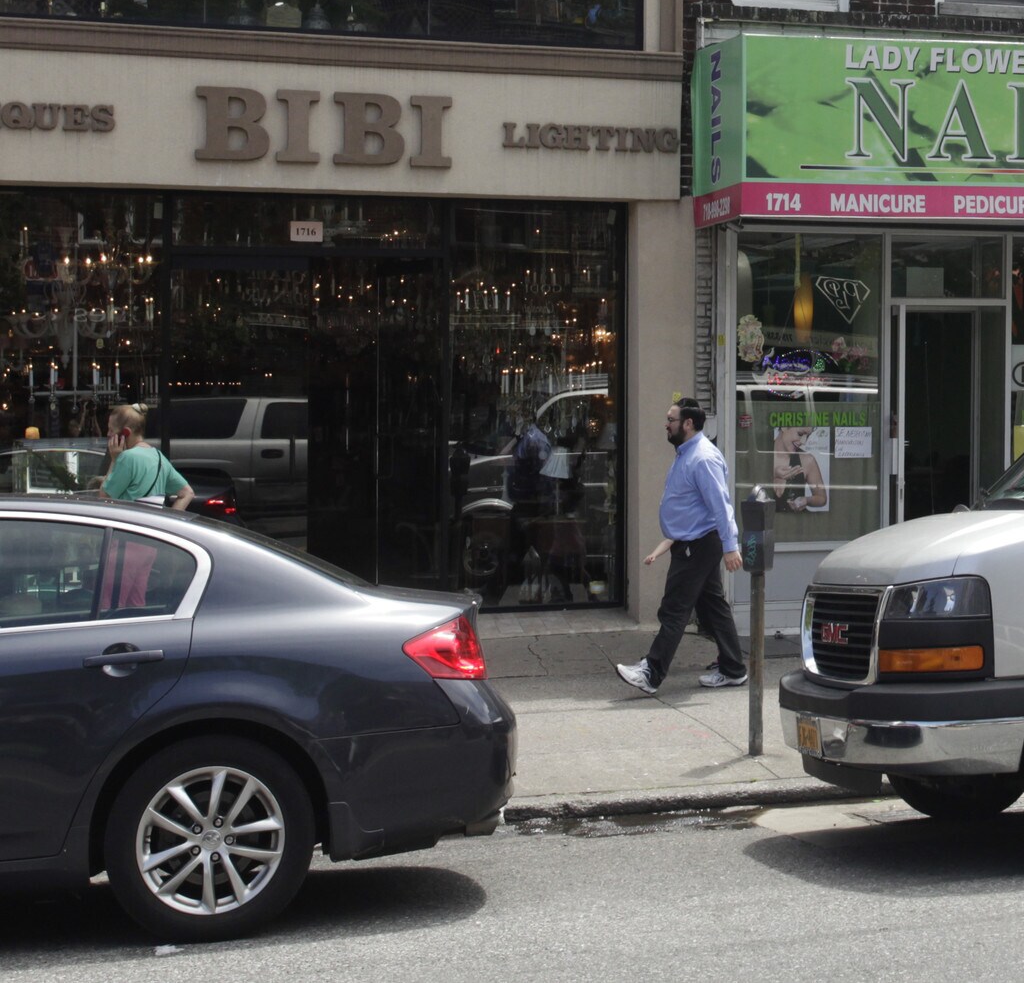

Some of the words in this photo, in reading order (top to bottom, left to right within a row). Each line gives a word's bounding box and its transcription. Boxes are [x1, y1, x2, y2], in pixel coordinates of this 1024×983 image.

[845, 44, 920, 71] LADY
[0, 102, 116, 132] QUES
[195, 86, 453, 168] BIBI
[710, 50, 722, 184] NAILS
[503, 122, 680, 153] LIGHTING
[766, 193, 801, 211] 1714
[830, 193, 926, 213] MANICURE
[296, 227, 317, 237] 1716
[769, 411, 830, 427] CHRISTINE
[832, 411, 866, 427] NAILS
[820, 622, 849, 645] GMC
